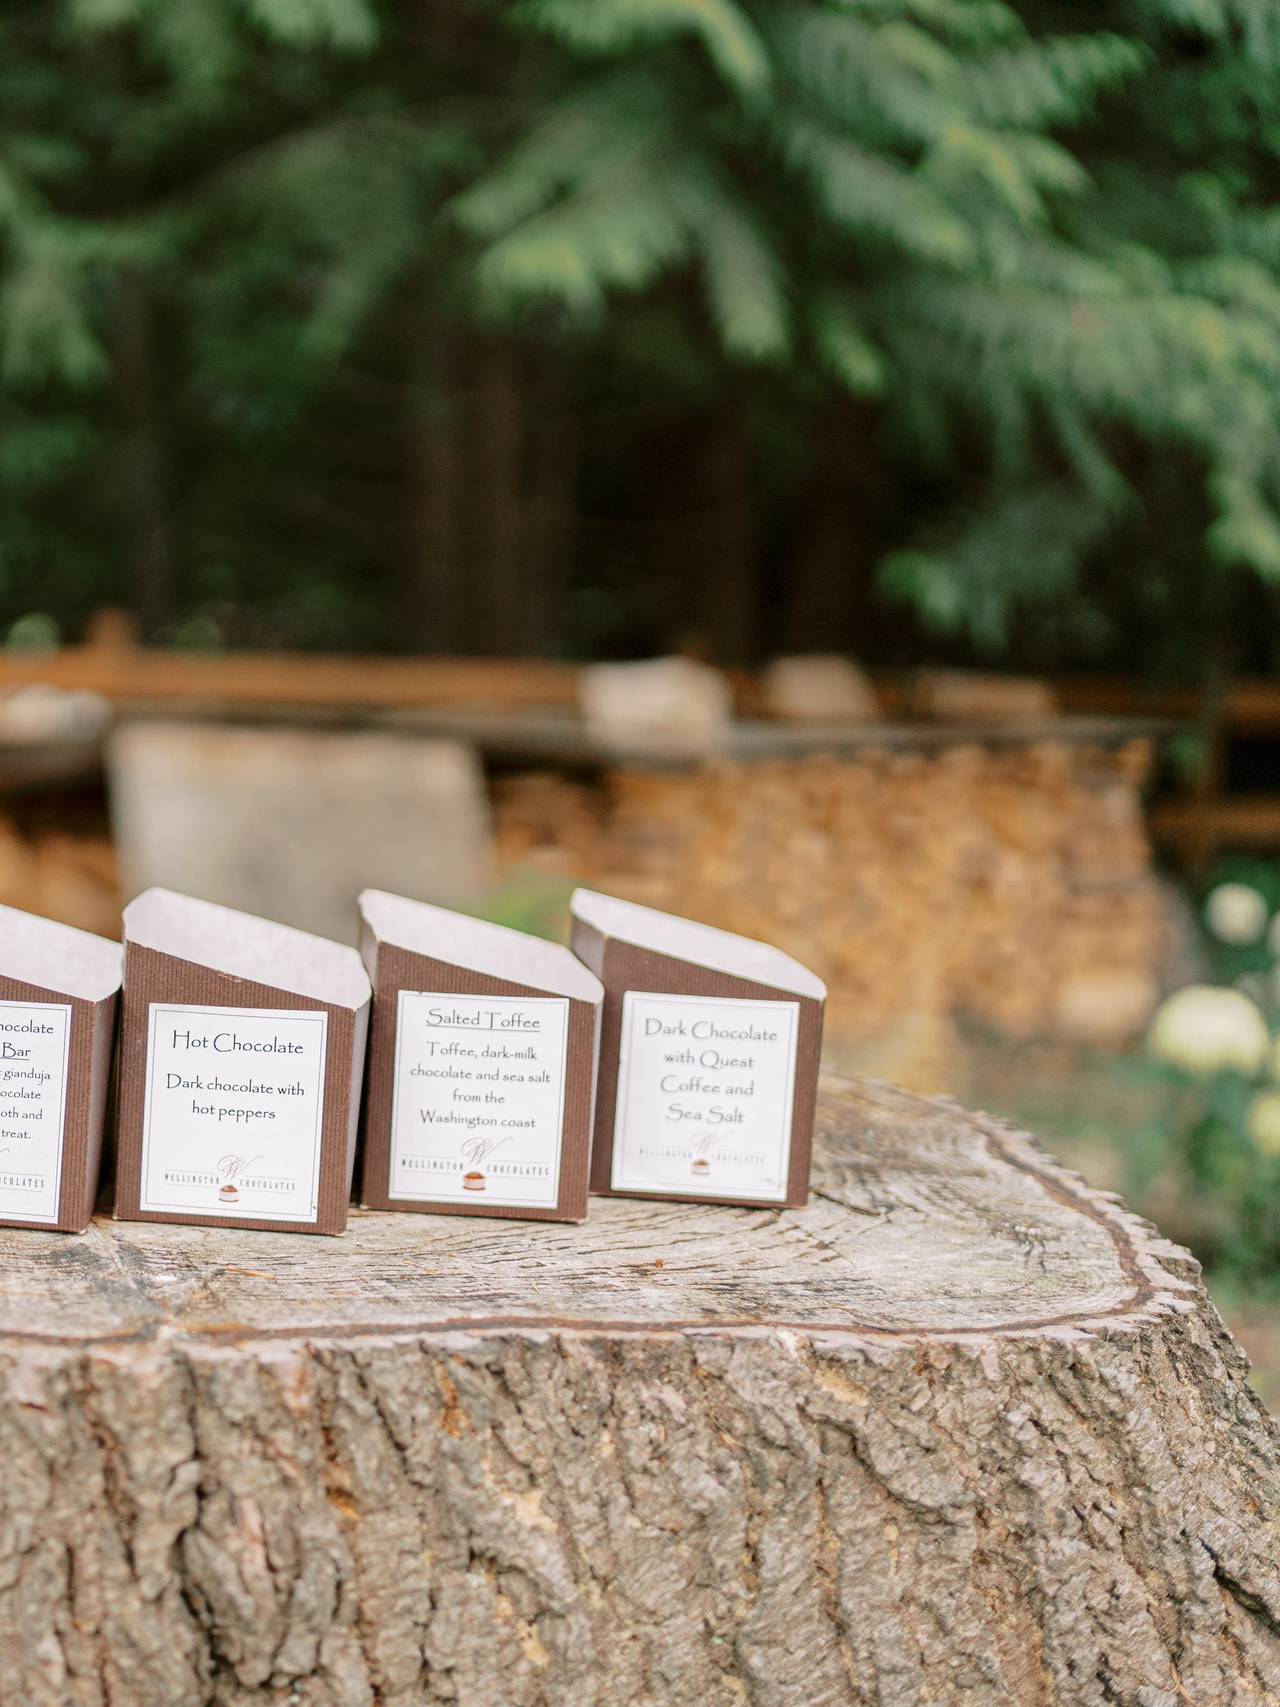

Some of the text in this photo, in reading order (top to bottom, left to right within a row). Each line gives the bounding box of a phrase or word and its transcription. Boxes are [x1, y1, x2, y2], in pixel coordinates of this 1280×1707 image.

[426, 1008, 540, 1028] Salted Toffee
[645, 1018, 778, 1041] Dark Chocolate
[2, 1042, 31, 1057] Bar
[172, 1030, 304, 1054] Hot Chocolate
[426, 1041, 537, 1060] Toffee, dark-milk
[664, 1048, 755, 1069] with Quest
[3, 1066, 50, 1085] gianduja
[410, 1063, 551, 1083] chocolate and sea salt
[166, 1073, 304, 1096] Dark chocolate with
[660, 1075, 754, 1095] Coffee and
[453, 1088, 505, 1103] from the
[22, 1109, 43, 1119] and
[192, 1100, 275, 1123] hot peppers
[420, 1109, 536, 1128] Washington coast
[665, 1103, 745, 1124] Sea Salt
[1, 1129, 31, 1139] treat.
[402, 1159, 549, 1175] WELLINGTON CHOCOLATES
[164, 1173, 296, 1190] WELLINGTON CHOCOLATES
